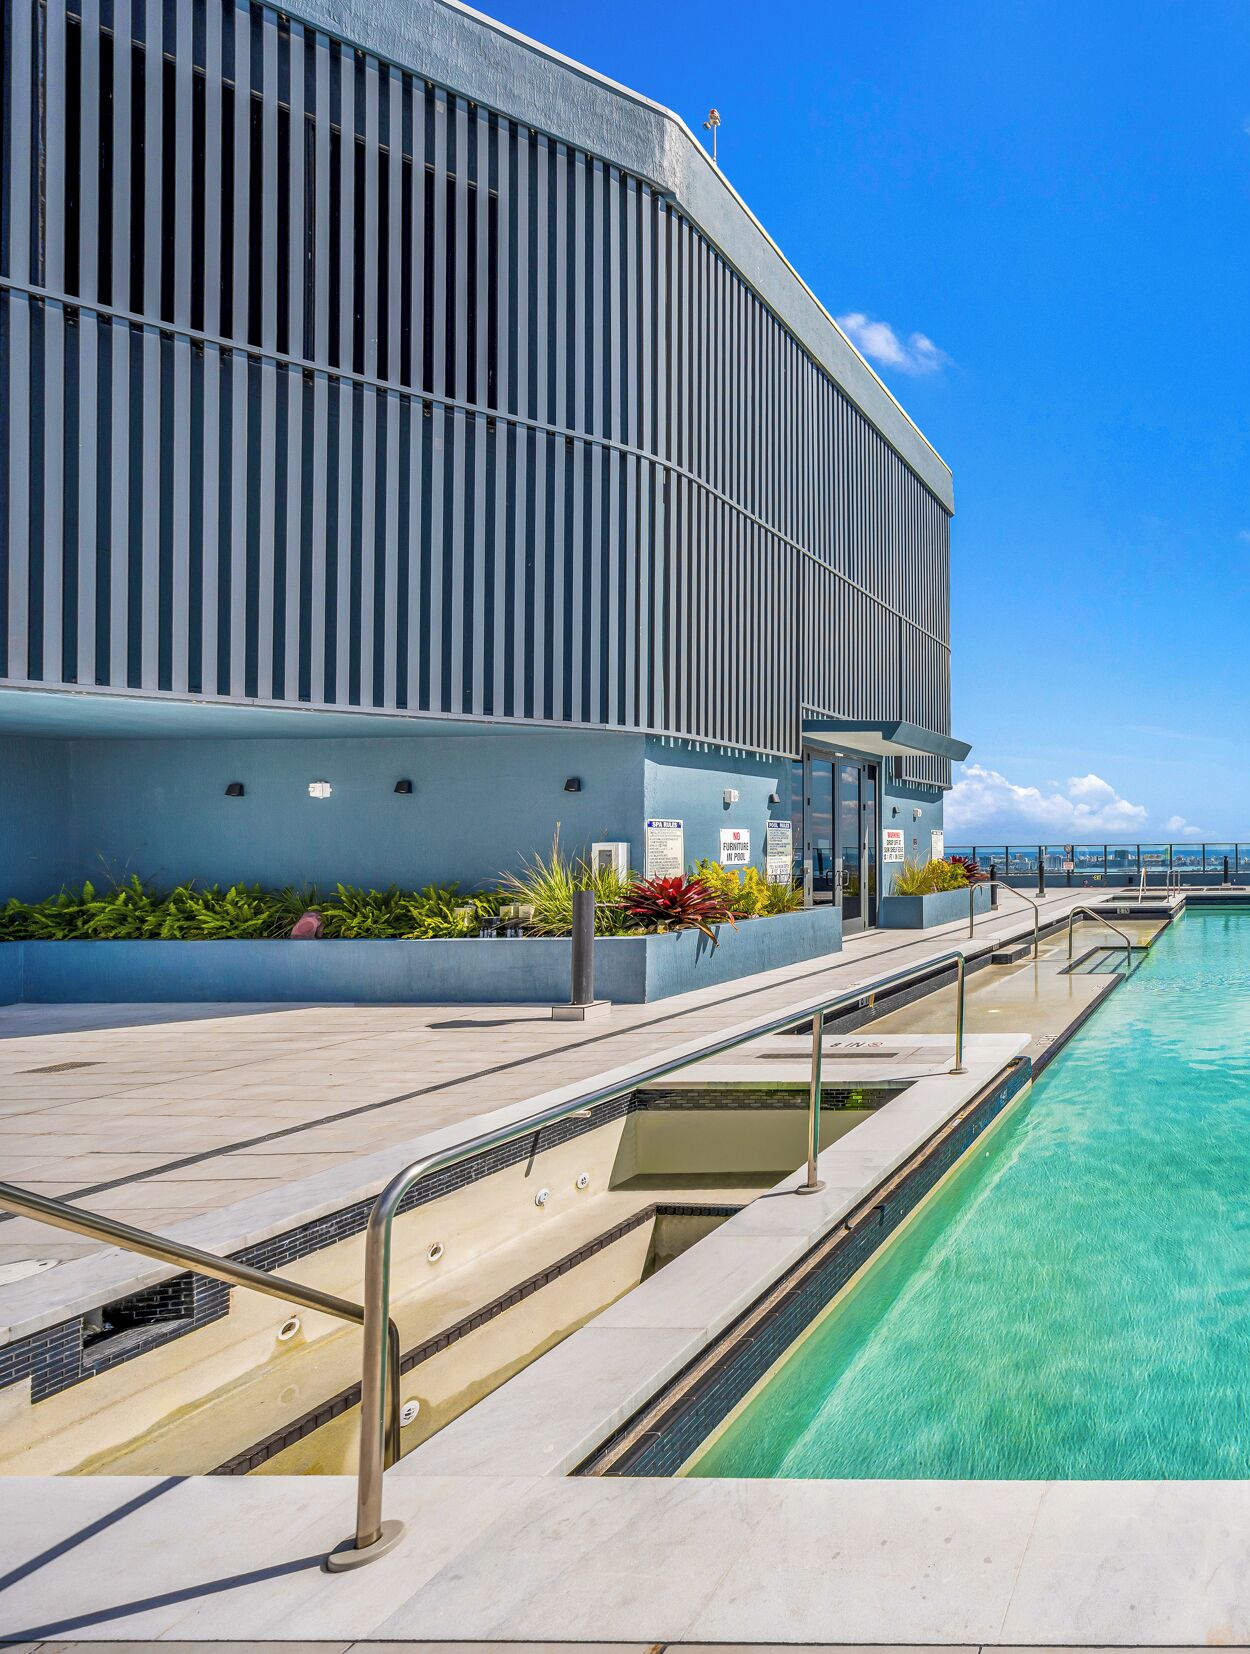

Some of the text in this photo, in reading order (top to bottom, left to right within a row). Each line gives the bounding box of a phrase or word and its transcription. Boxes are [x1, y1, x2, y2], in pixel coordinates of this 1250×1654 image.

[733, 832, 740, 841] NO
[723, 842, 749, 851] FURNITURE
[726, 852, 746, 861] IN POOL
